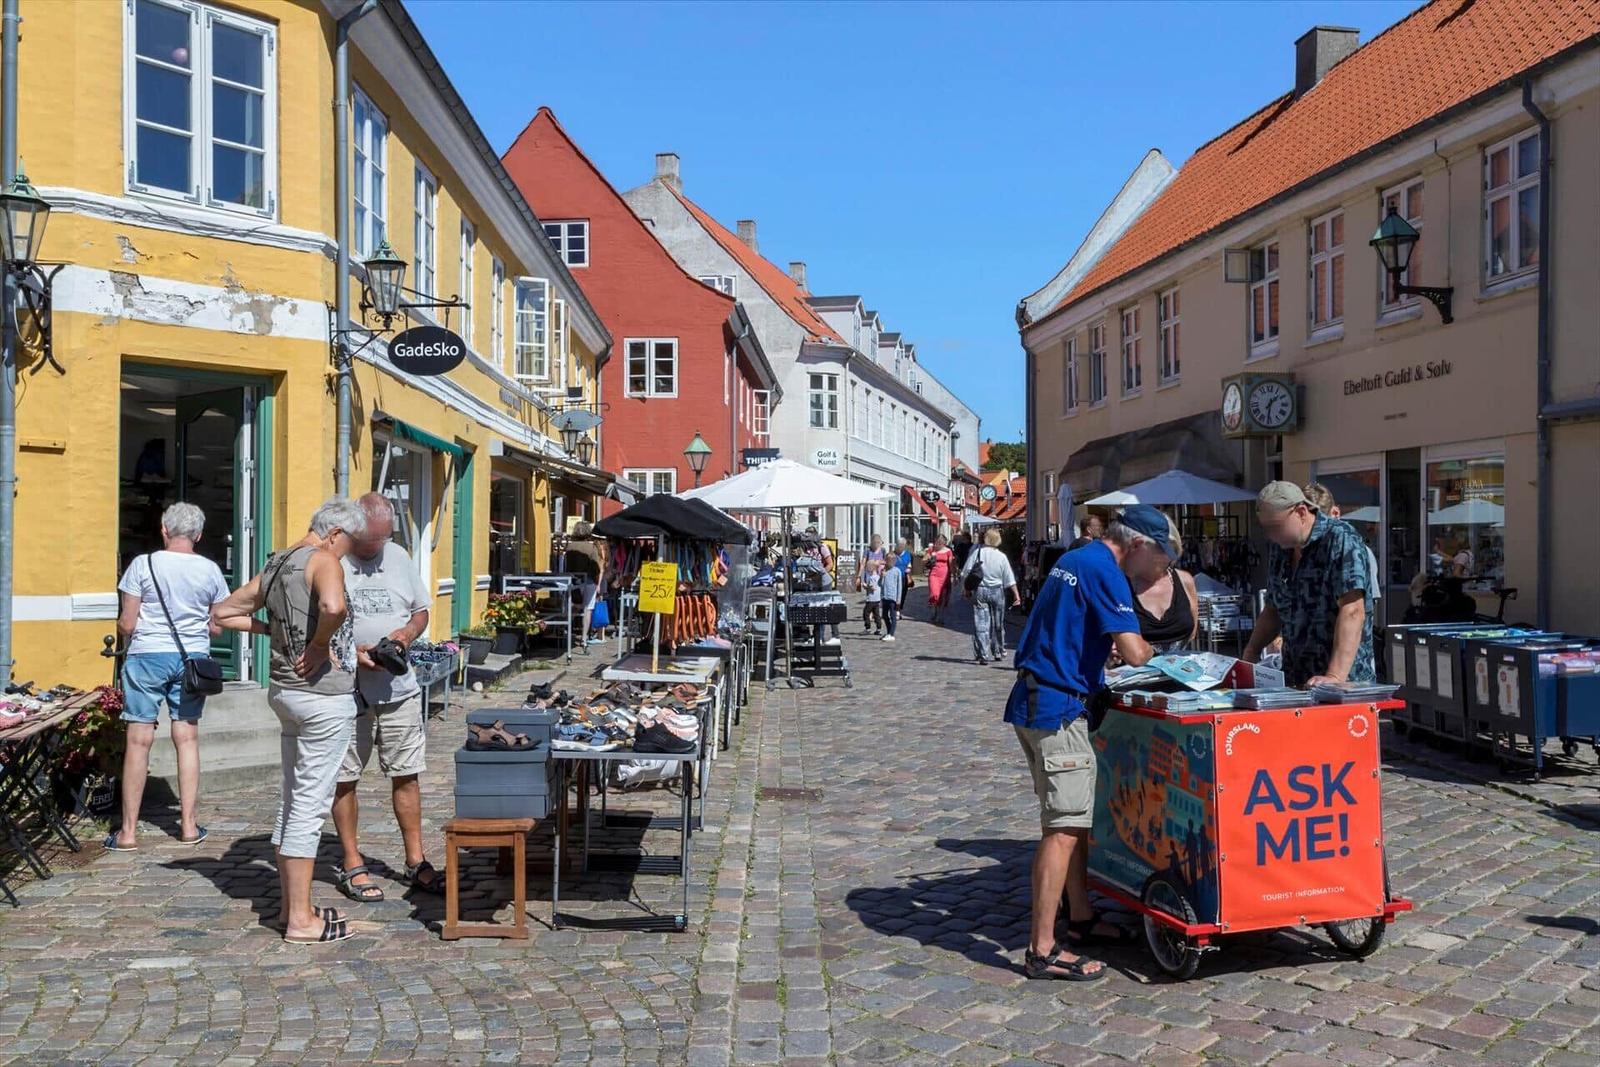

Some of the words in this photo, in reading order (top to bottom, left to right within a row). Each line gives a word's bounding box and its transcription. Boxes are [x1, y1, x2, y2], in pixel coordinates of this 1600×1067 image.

[394, 342, 459, 357] GadeSko
[1343, 374, 1382, 396] Ebeltoft
[1385, 366, 1411, 387] Guld
[1414, 364, 1424, 381] &
[1426, 359, 1452, 379] Sølv
[817, 450, 832, 458] Golf
[818, 458, 837, 466] Kunst
[1225, 722, 1261, 756] DJURSLAND
[1243, 760, 1358, 816] ASK
[1255, 812, 1350, 867] ME!
[1263, 891, 1293, 901] TOURIST
[1295, 885, 1345, 898] INFORMATION
